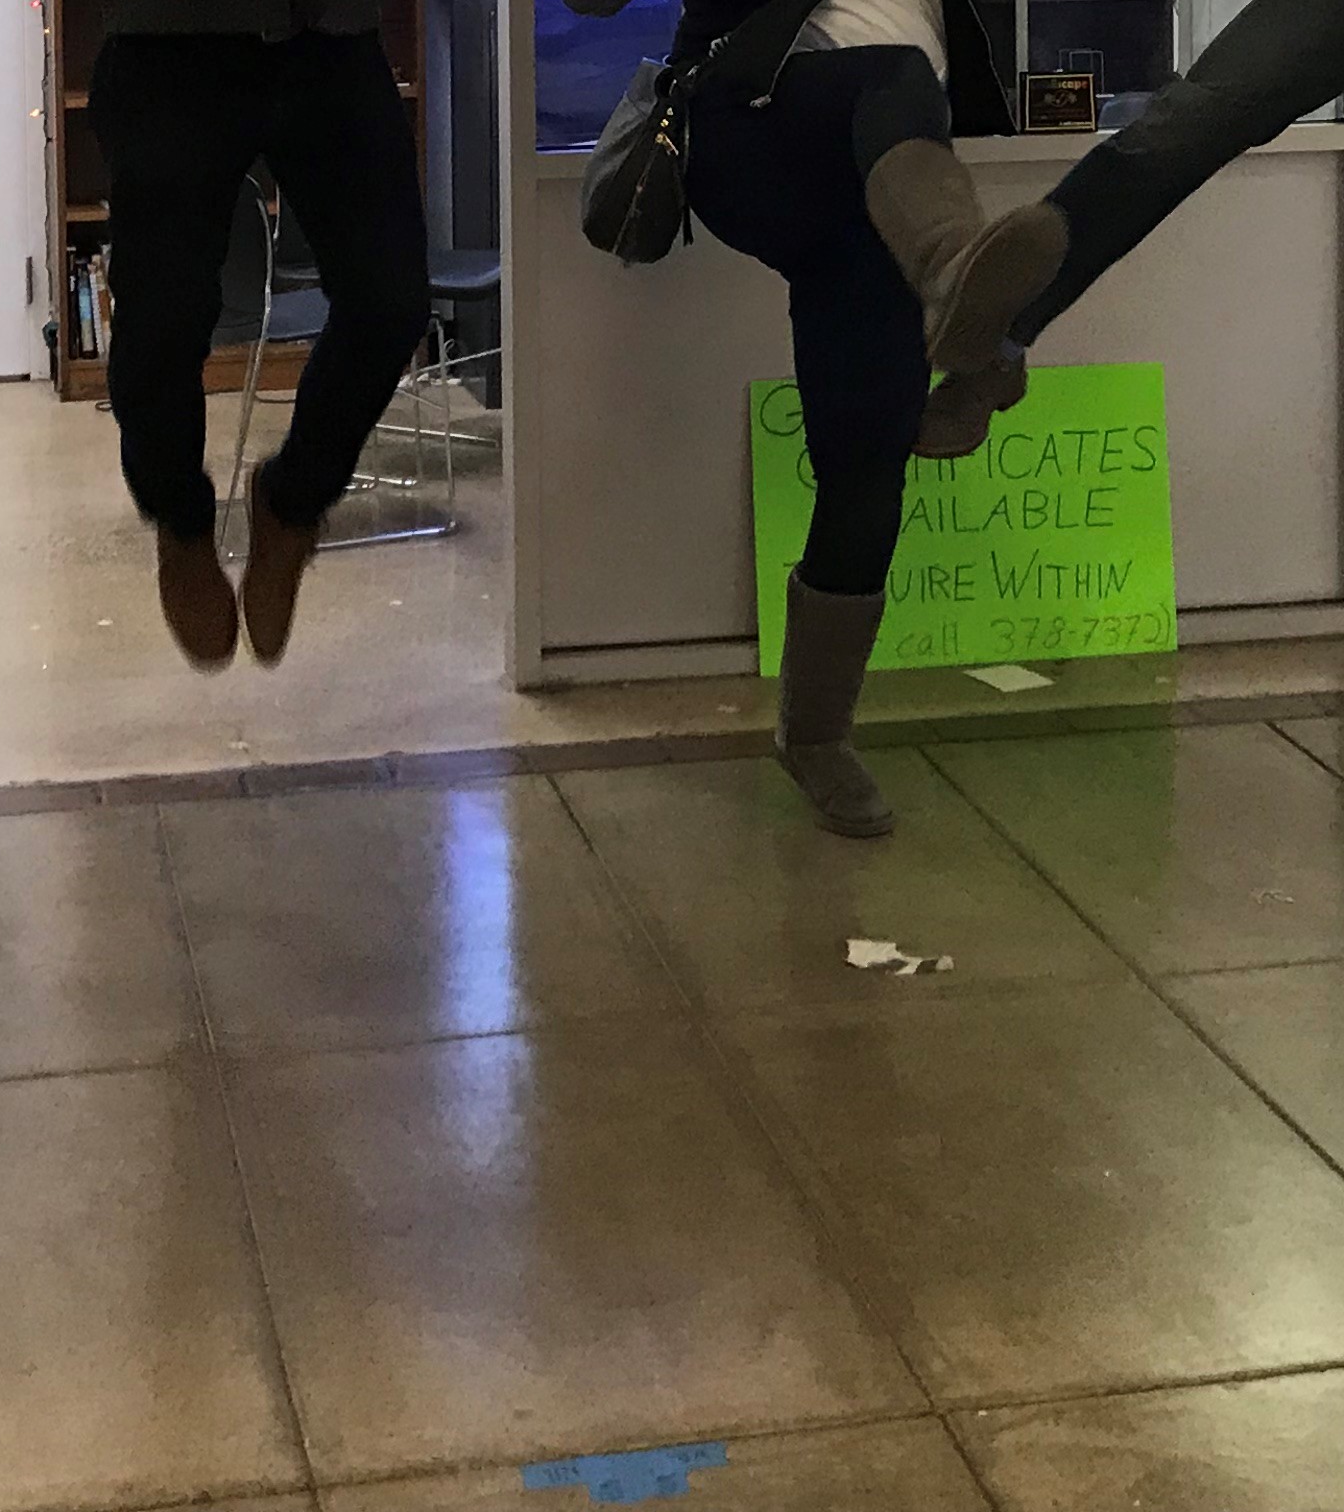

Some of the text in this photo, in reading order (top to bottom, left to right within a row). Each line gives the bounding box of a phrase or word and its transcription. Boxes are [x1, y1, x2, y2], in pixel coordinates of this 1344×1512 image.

[901, 486, 1120, 534] AILABLE
[990, 548, 1133, 601] WITHIN
[895, 620, 959, 661] call
